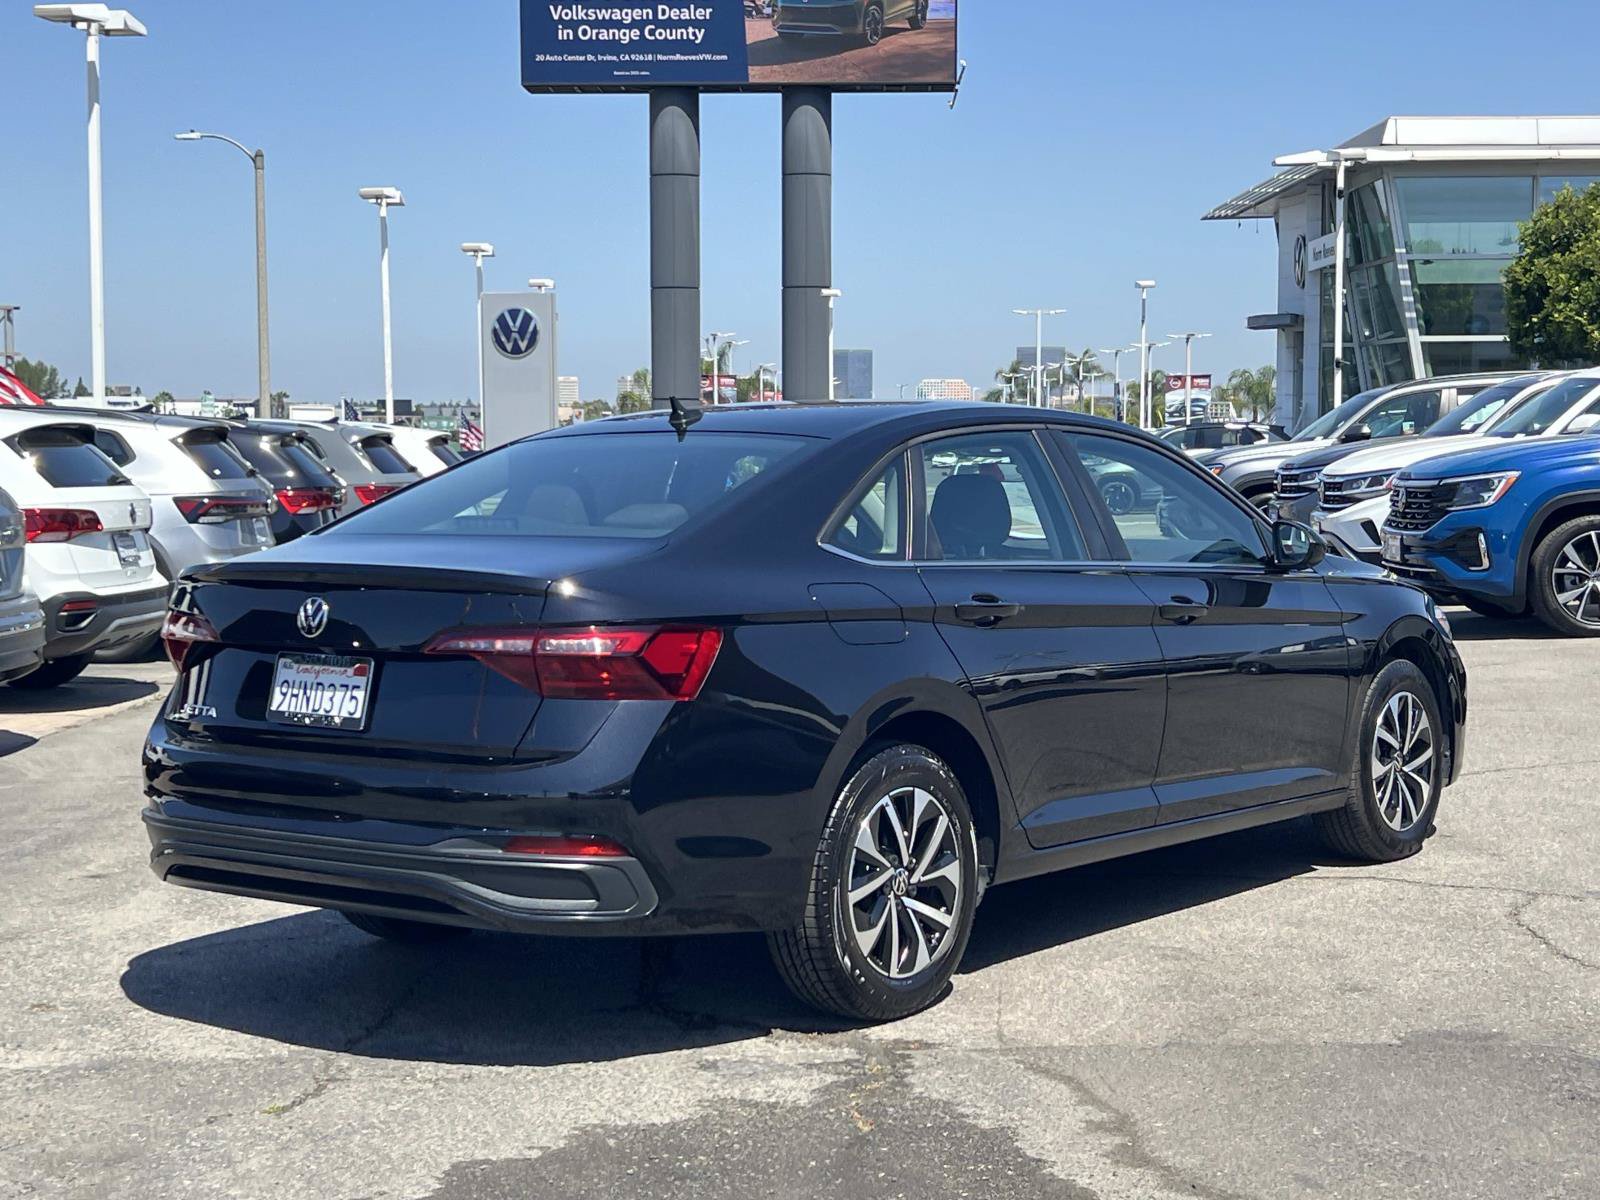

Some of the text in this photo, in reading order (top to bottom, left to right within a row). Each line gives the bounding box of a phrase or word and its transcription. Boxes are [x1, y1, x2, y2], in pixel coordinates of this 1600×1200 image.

[549, 4, 713, 24] Volkswagen Dealer
[557, 25, 705, 44] in Orange County
[535, 54, 728, 63] 20 Auto Center Dr, Irvine, CA 92618 NormReevesVW.com
[276, 680, 361, 716] 9HND375
[180, 703, 217, 718] JETTA
